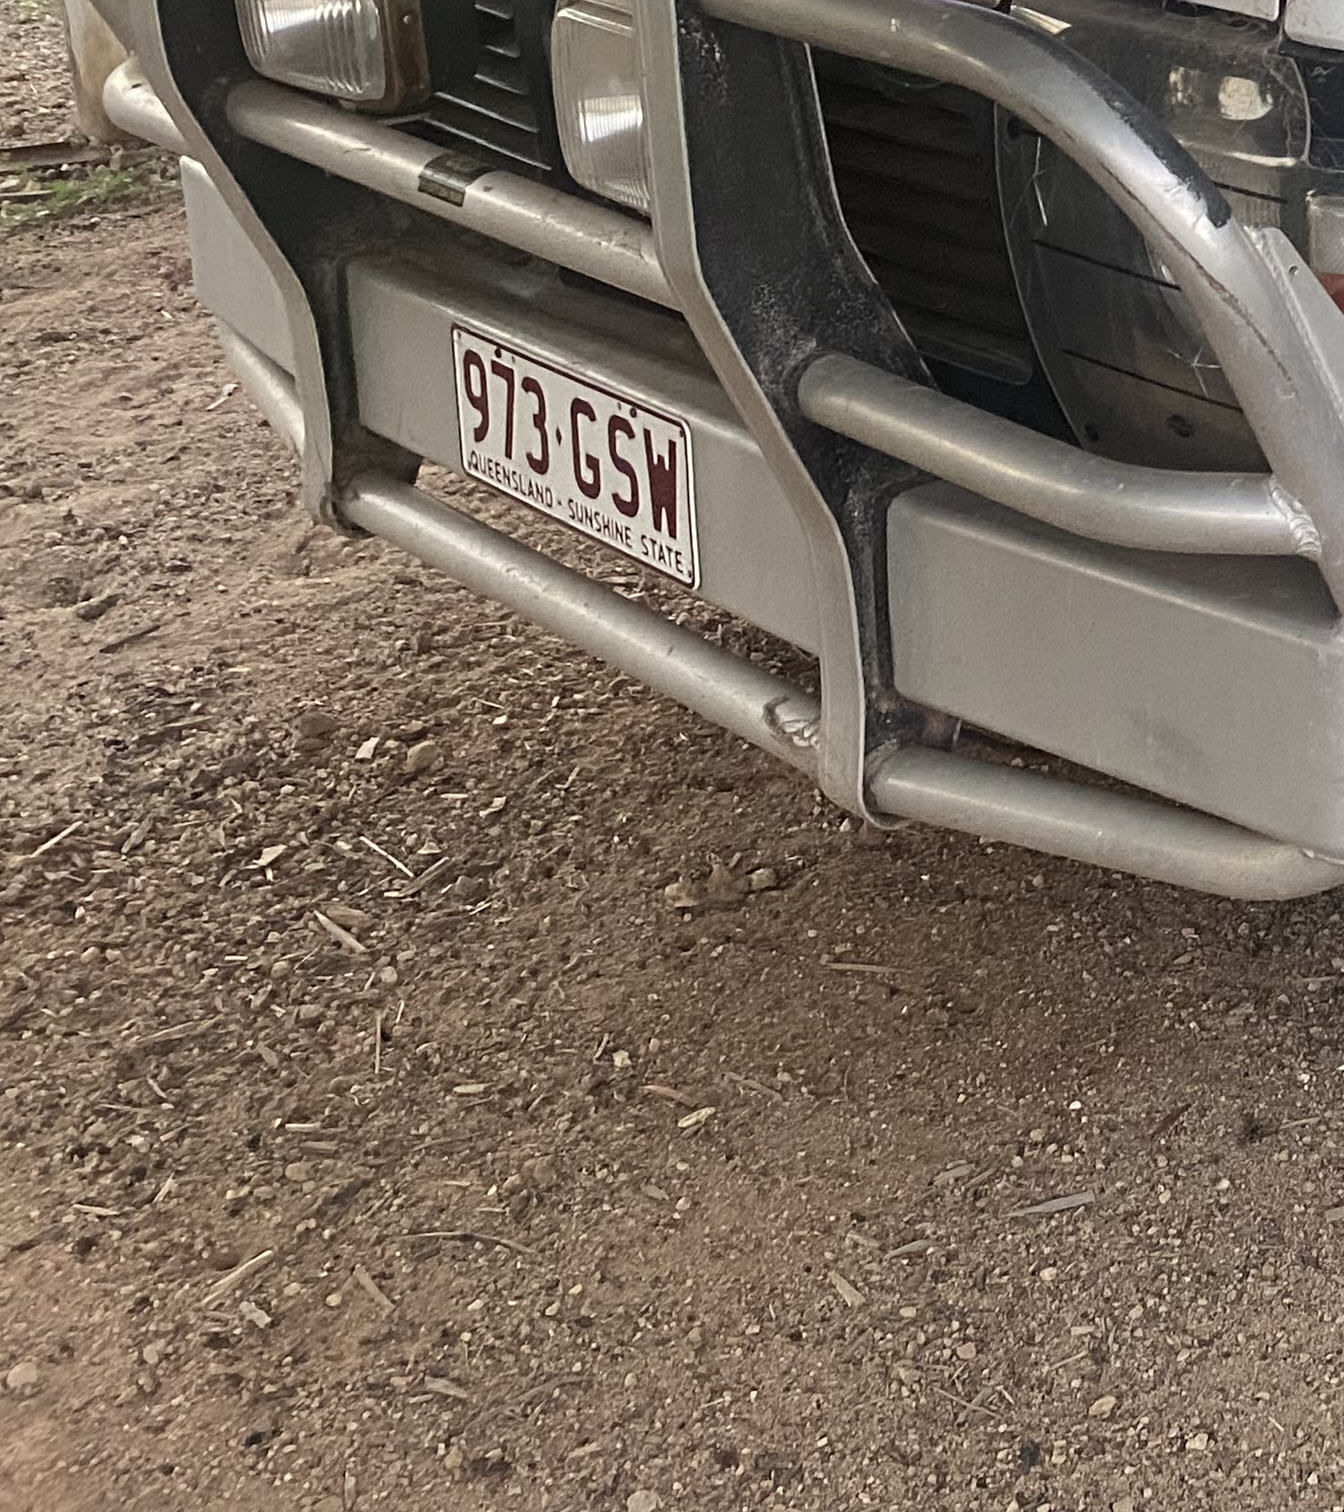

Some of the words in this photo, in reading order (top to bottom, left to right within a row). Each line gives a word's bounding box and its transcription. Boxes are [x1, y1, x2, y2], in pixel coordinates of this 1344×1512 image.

[467, 450, 553, 508] QUEENSLAND
[568, 498, 633, 548] SUNSHINE
[640, 534, 684, 575] STATE
